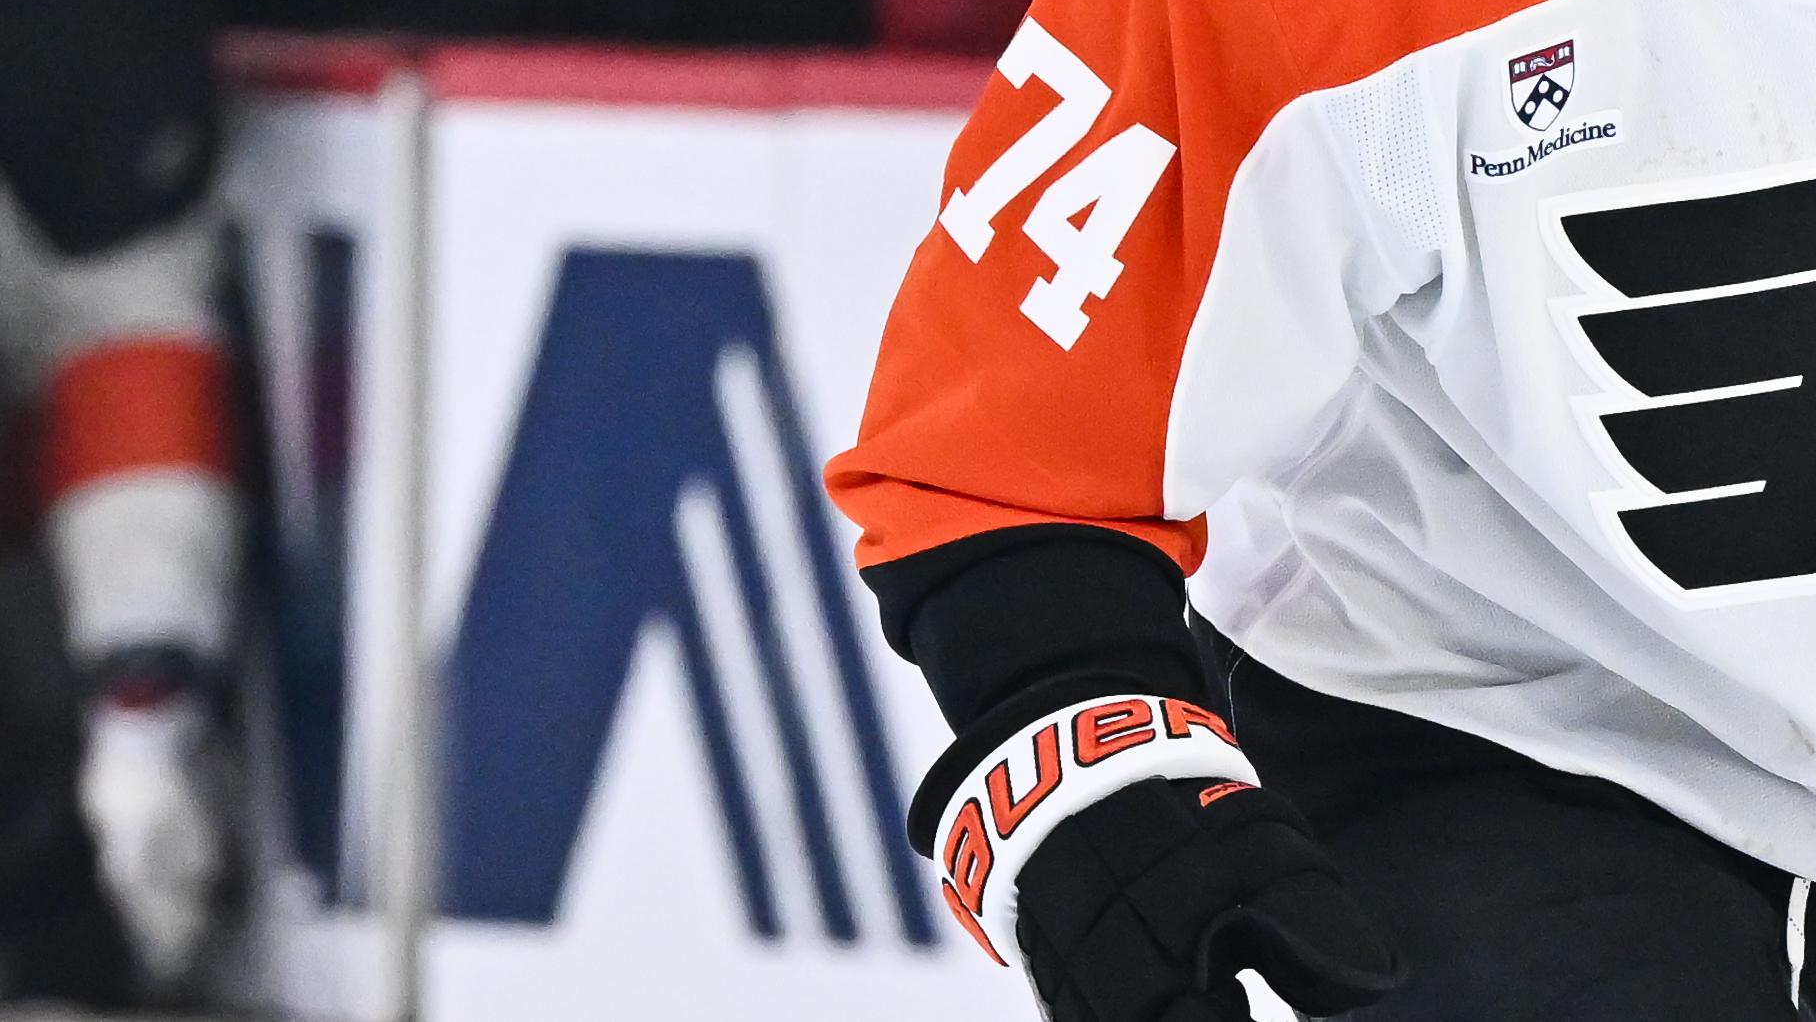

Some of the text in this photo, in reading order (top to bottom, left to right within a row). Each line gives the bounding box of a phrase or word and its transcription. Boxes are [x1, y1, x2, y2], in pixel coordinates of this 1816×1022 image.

[938, 14, 1179, 353] 74
[1469, 121, 1617, 177] Penn Medicine
